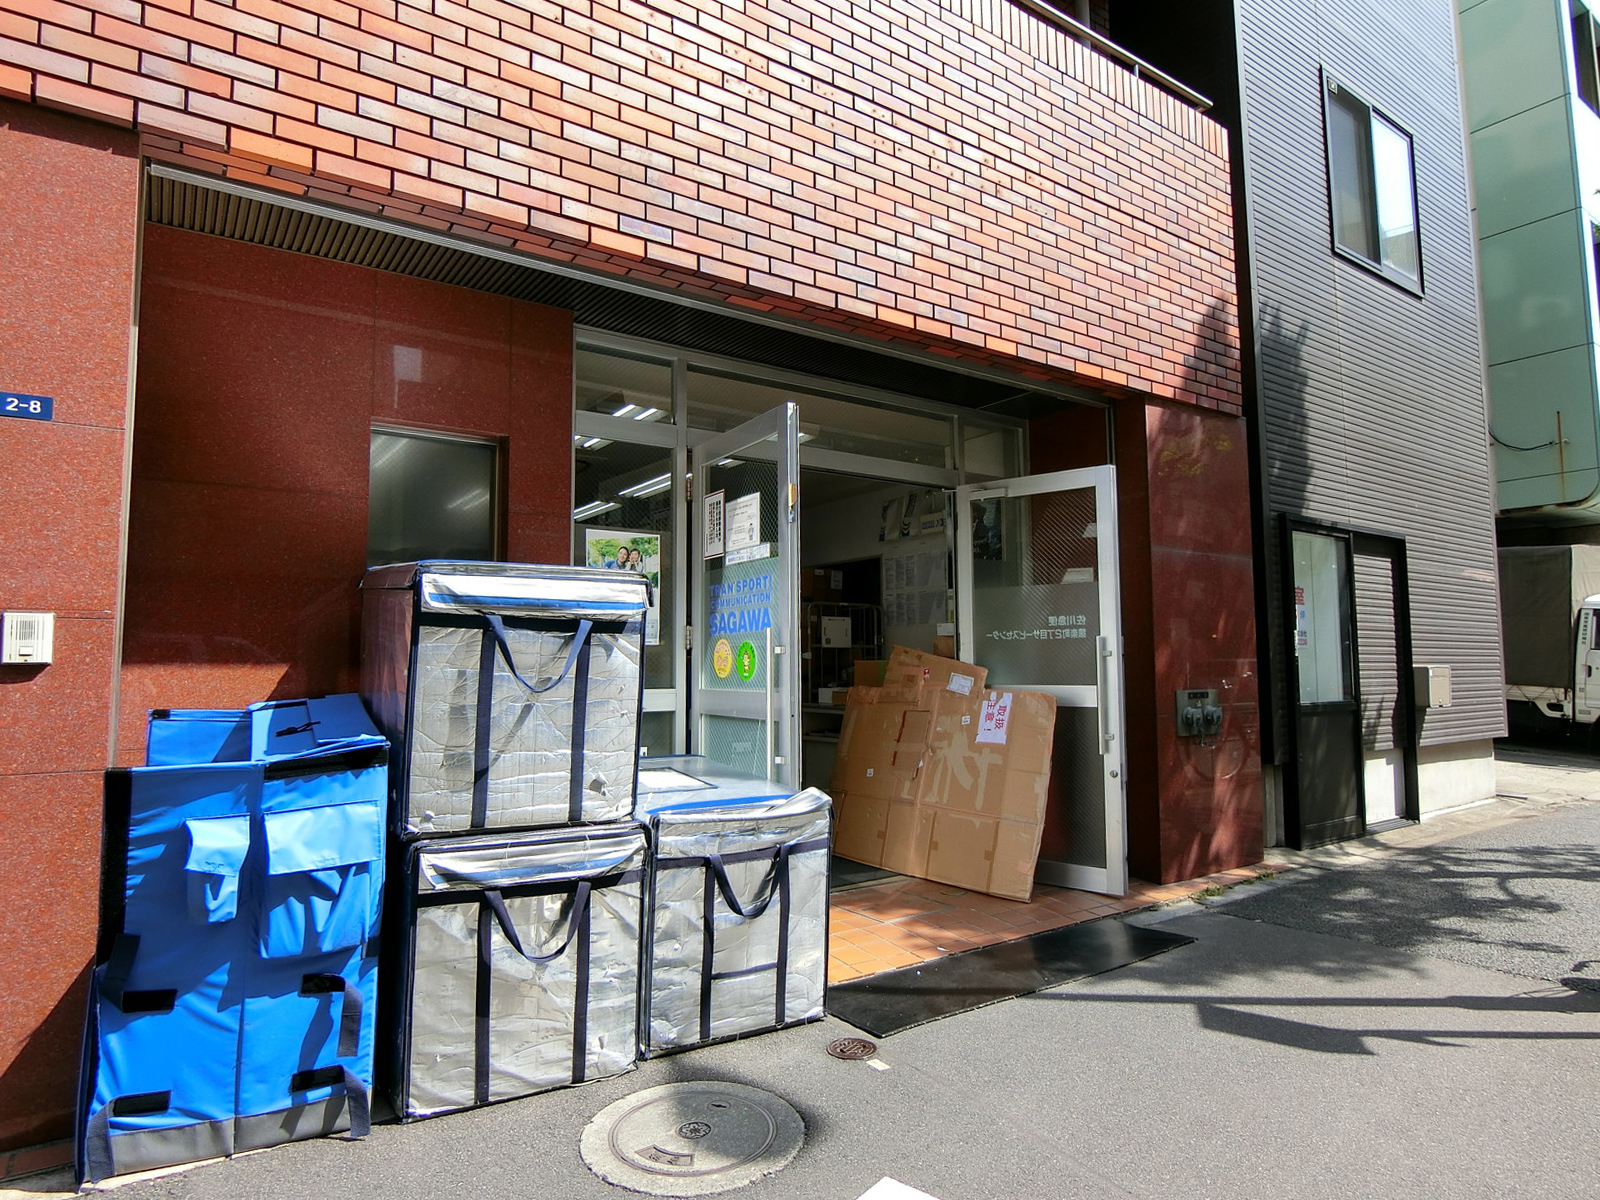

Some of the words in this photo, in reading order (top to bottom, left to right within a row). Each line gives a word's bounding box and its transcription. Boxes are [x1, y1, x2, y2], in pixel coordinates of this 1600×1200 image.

[5, 397, 42, 414] 2-8
[709, 591, 771, 611] COMMUNICATION
[708, 606, 772, 636] SAGAWA
